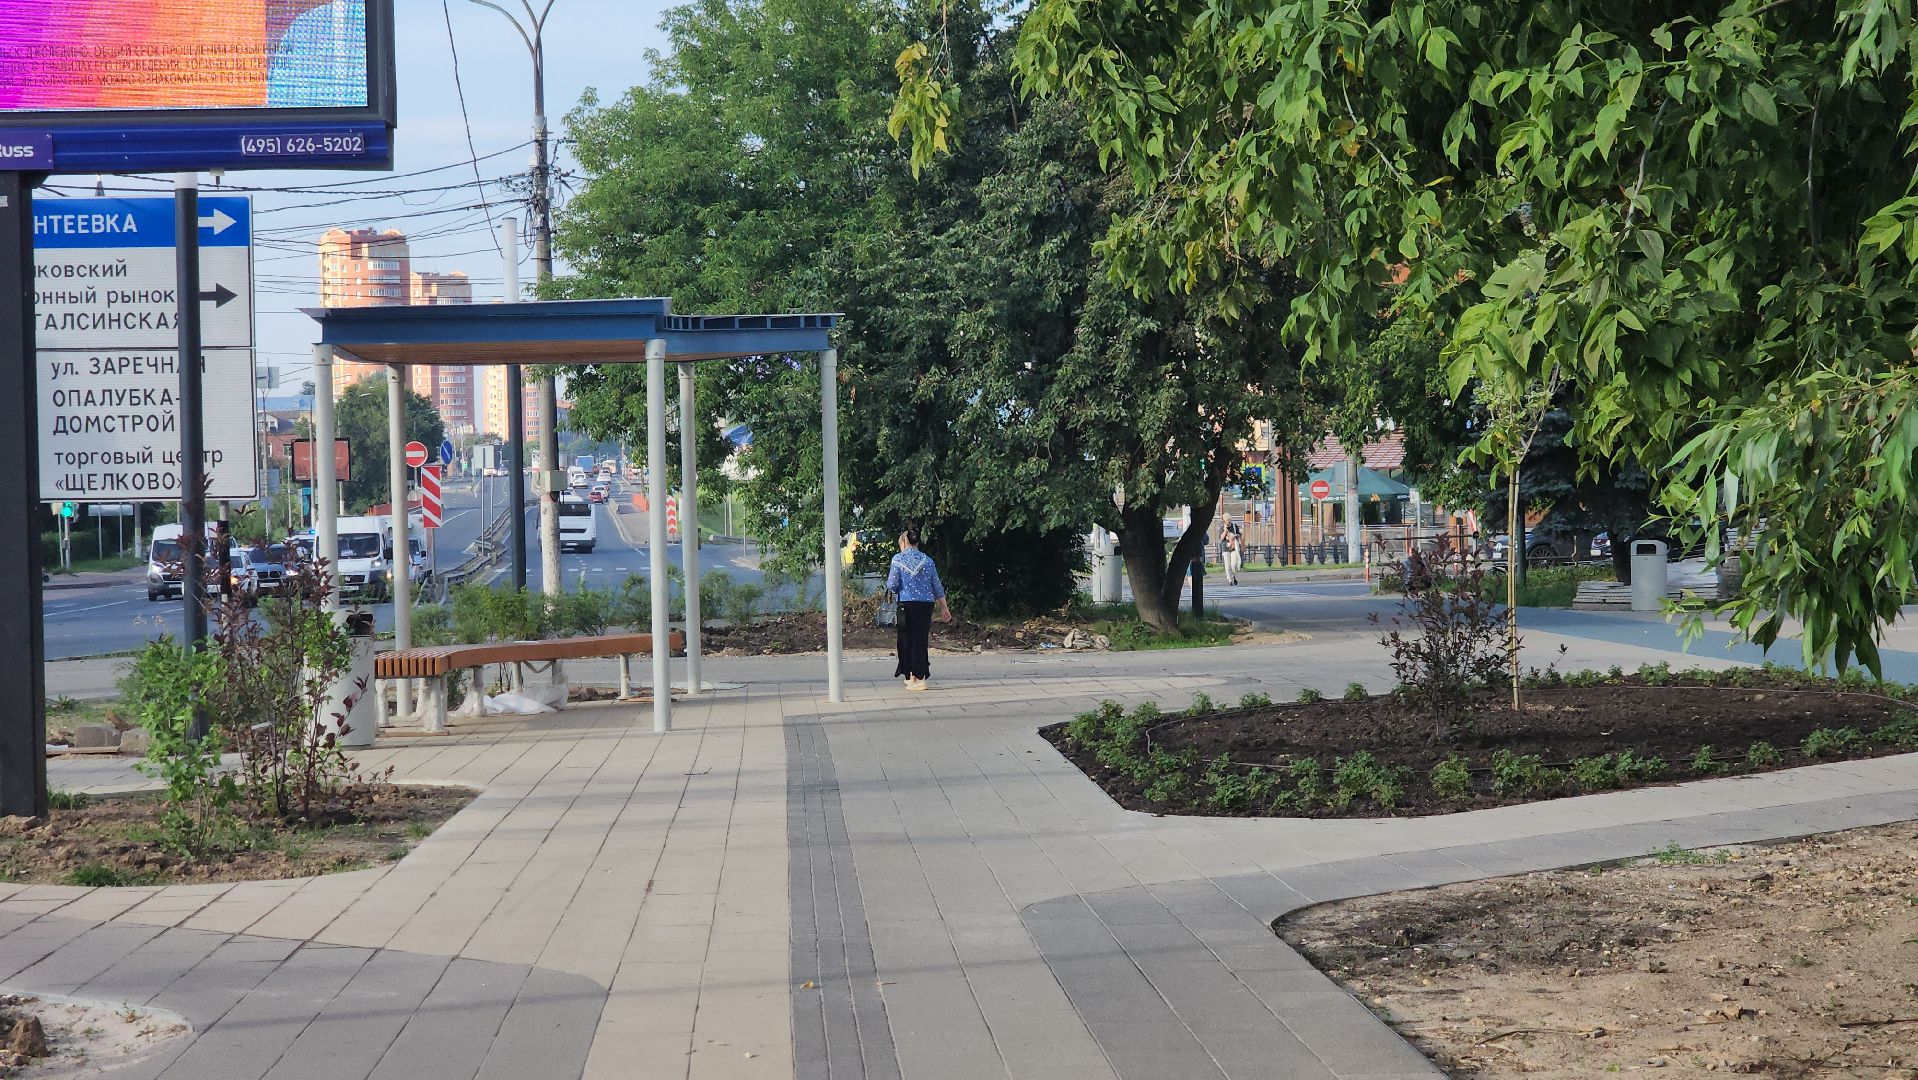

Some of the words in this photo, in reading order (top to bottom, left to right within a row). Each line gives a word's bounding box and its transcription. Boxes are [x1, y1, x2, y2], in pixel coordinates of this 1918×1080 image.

[241, 136, 280, 154] (495)
[286, 137, 361, 153] 626-5202
[34, 213, 138, 234] НТЕЕВКА
[34, 259, 127, 278] ковский
[107, 290, 175, 309] рынок
[51, 361, 80, 380] ул.
[89, 355, 206, 376] ЗАРЕЧНЯ
[52, 388, 180, 407] ОПАЛУБКА-
[53, 410, 175, 436] ДОМСТРОЙ
[54, 446, 153, 468] торговый
[162, 449, 223, 468] цетр
